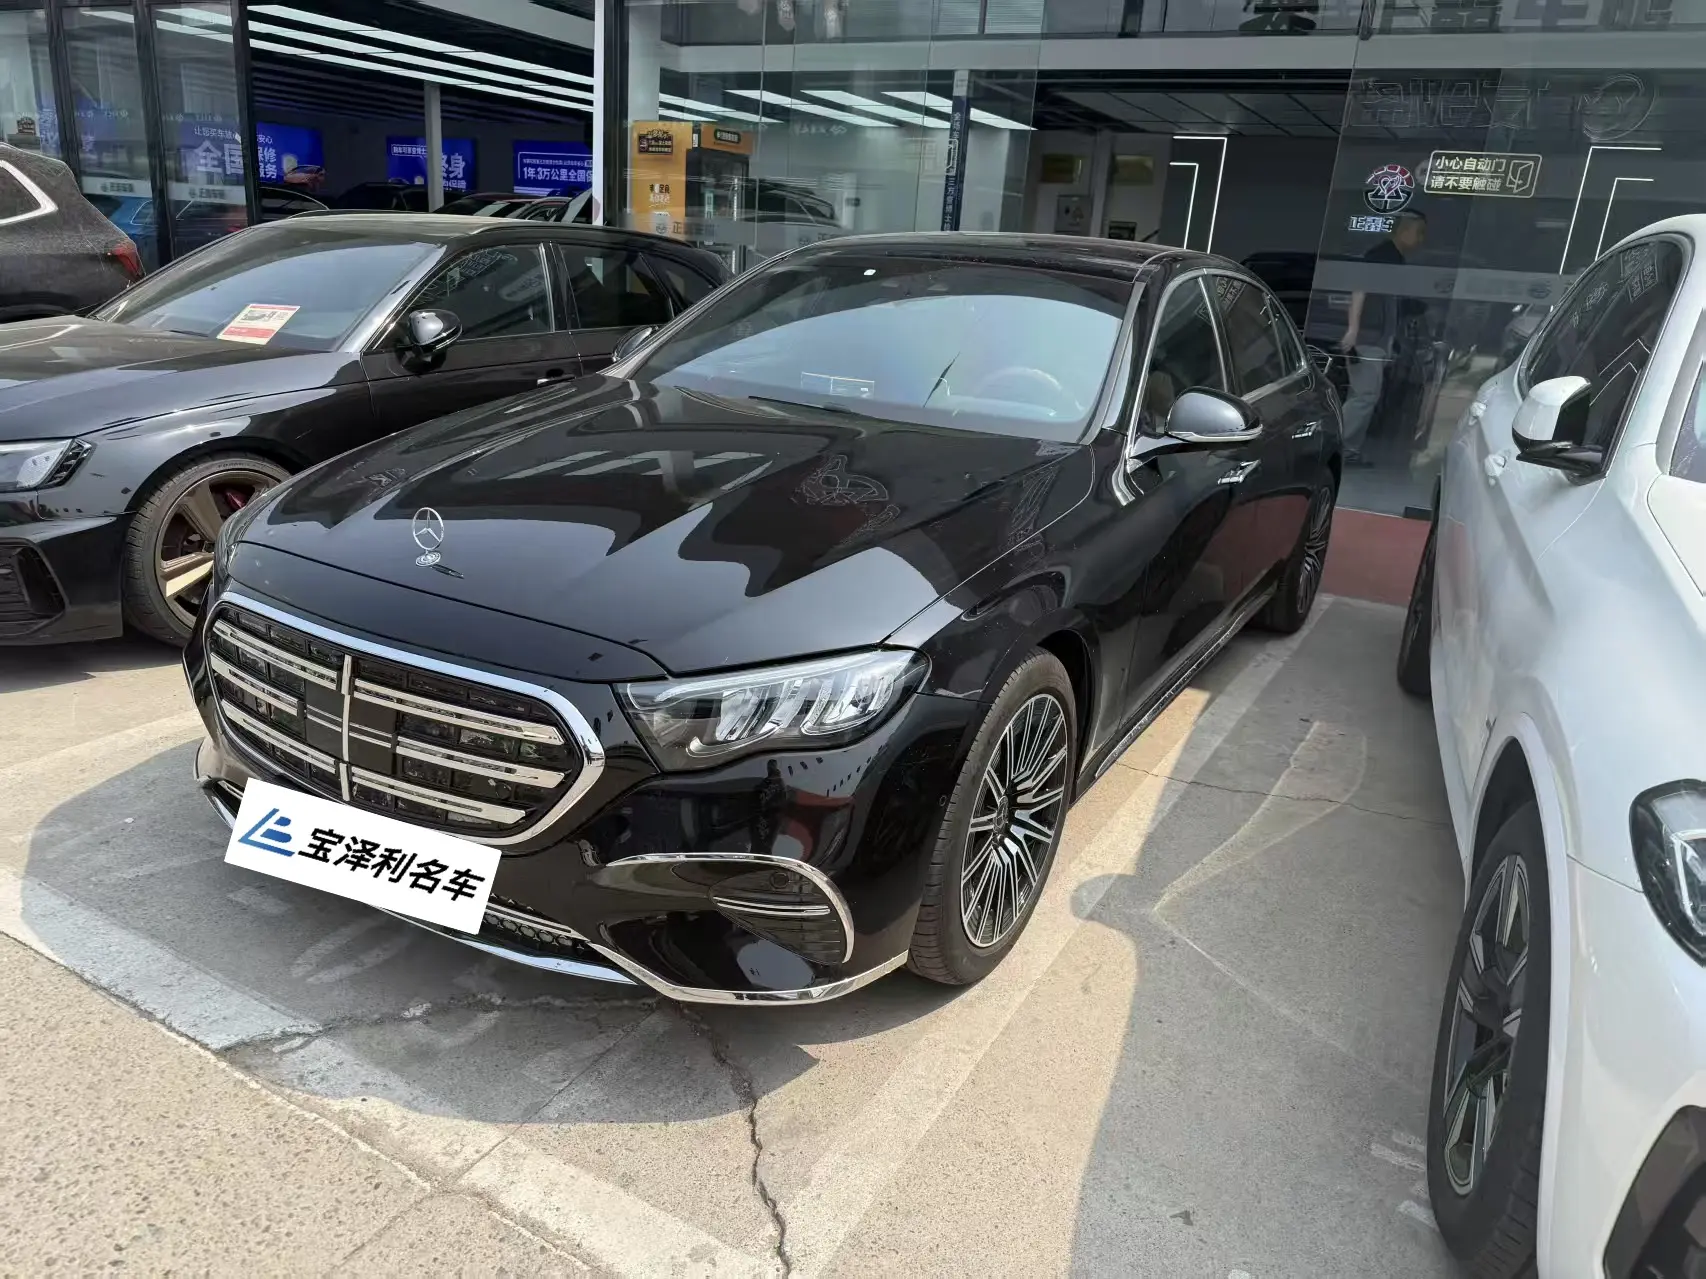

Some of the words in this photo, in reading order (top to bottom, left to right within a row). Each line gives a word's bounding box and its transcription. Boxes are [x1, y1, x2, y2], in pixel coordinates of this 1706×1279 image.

[1435, 155, 1507, 172] 小心自动门
[1430, 175, 1502, 192] 请不要触碰
